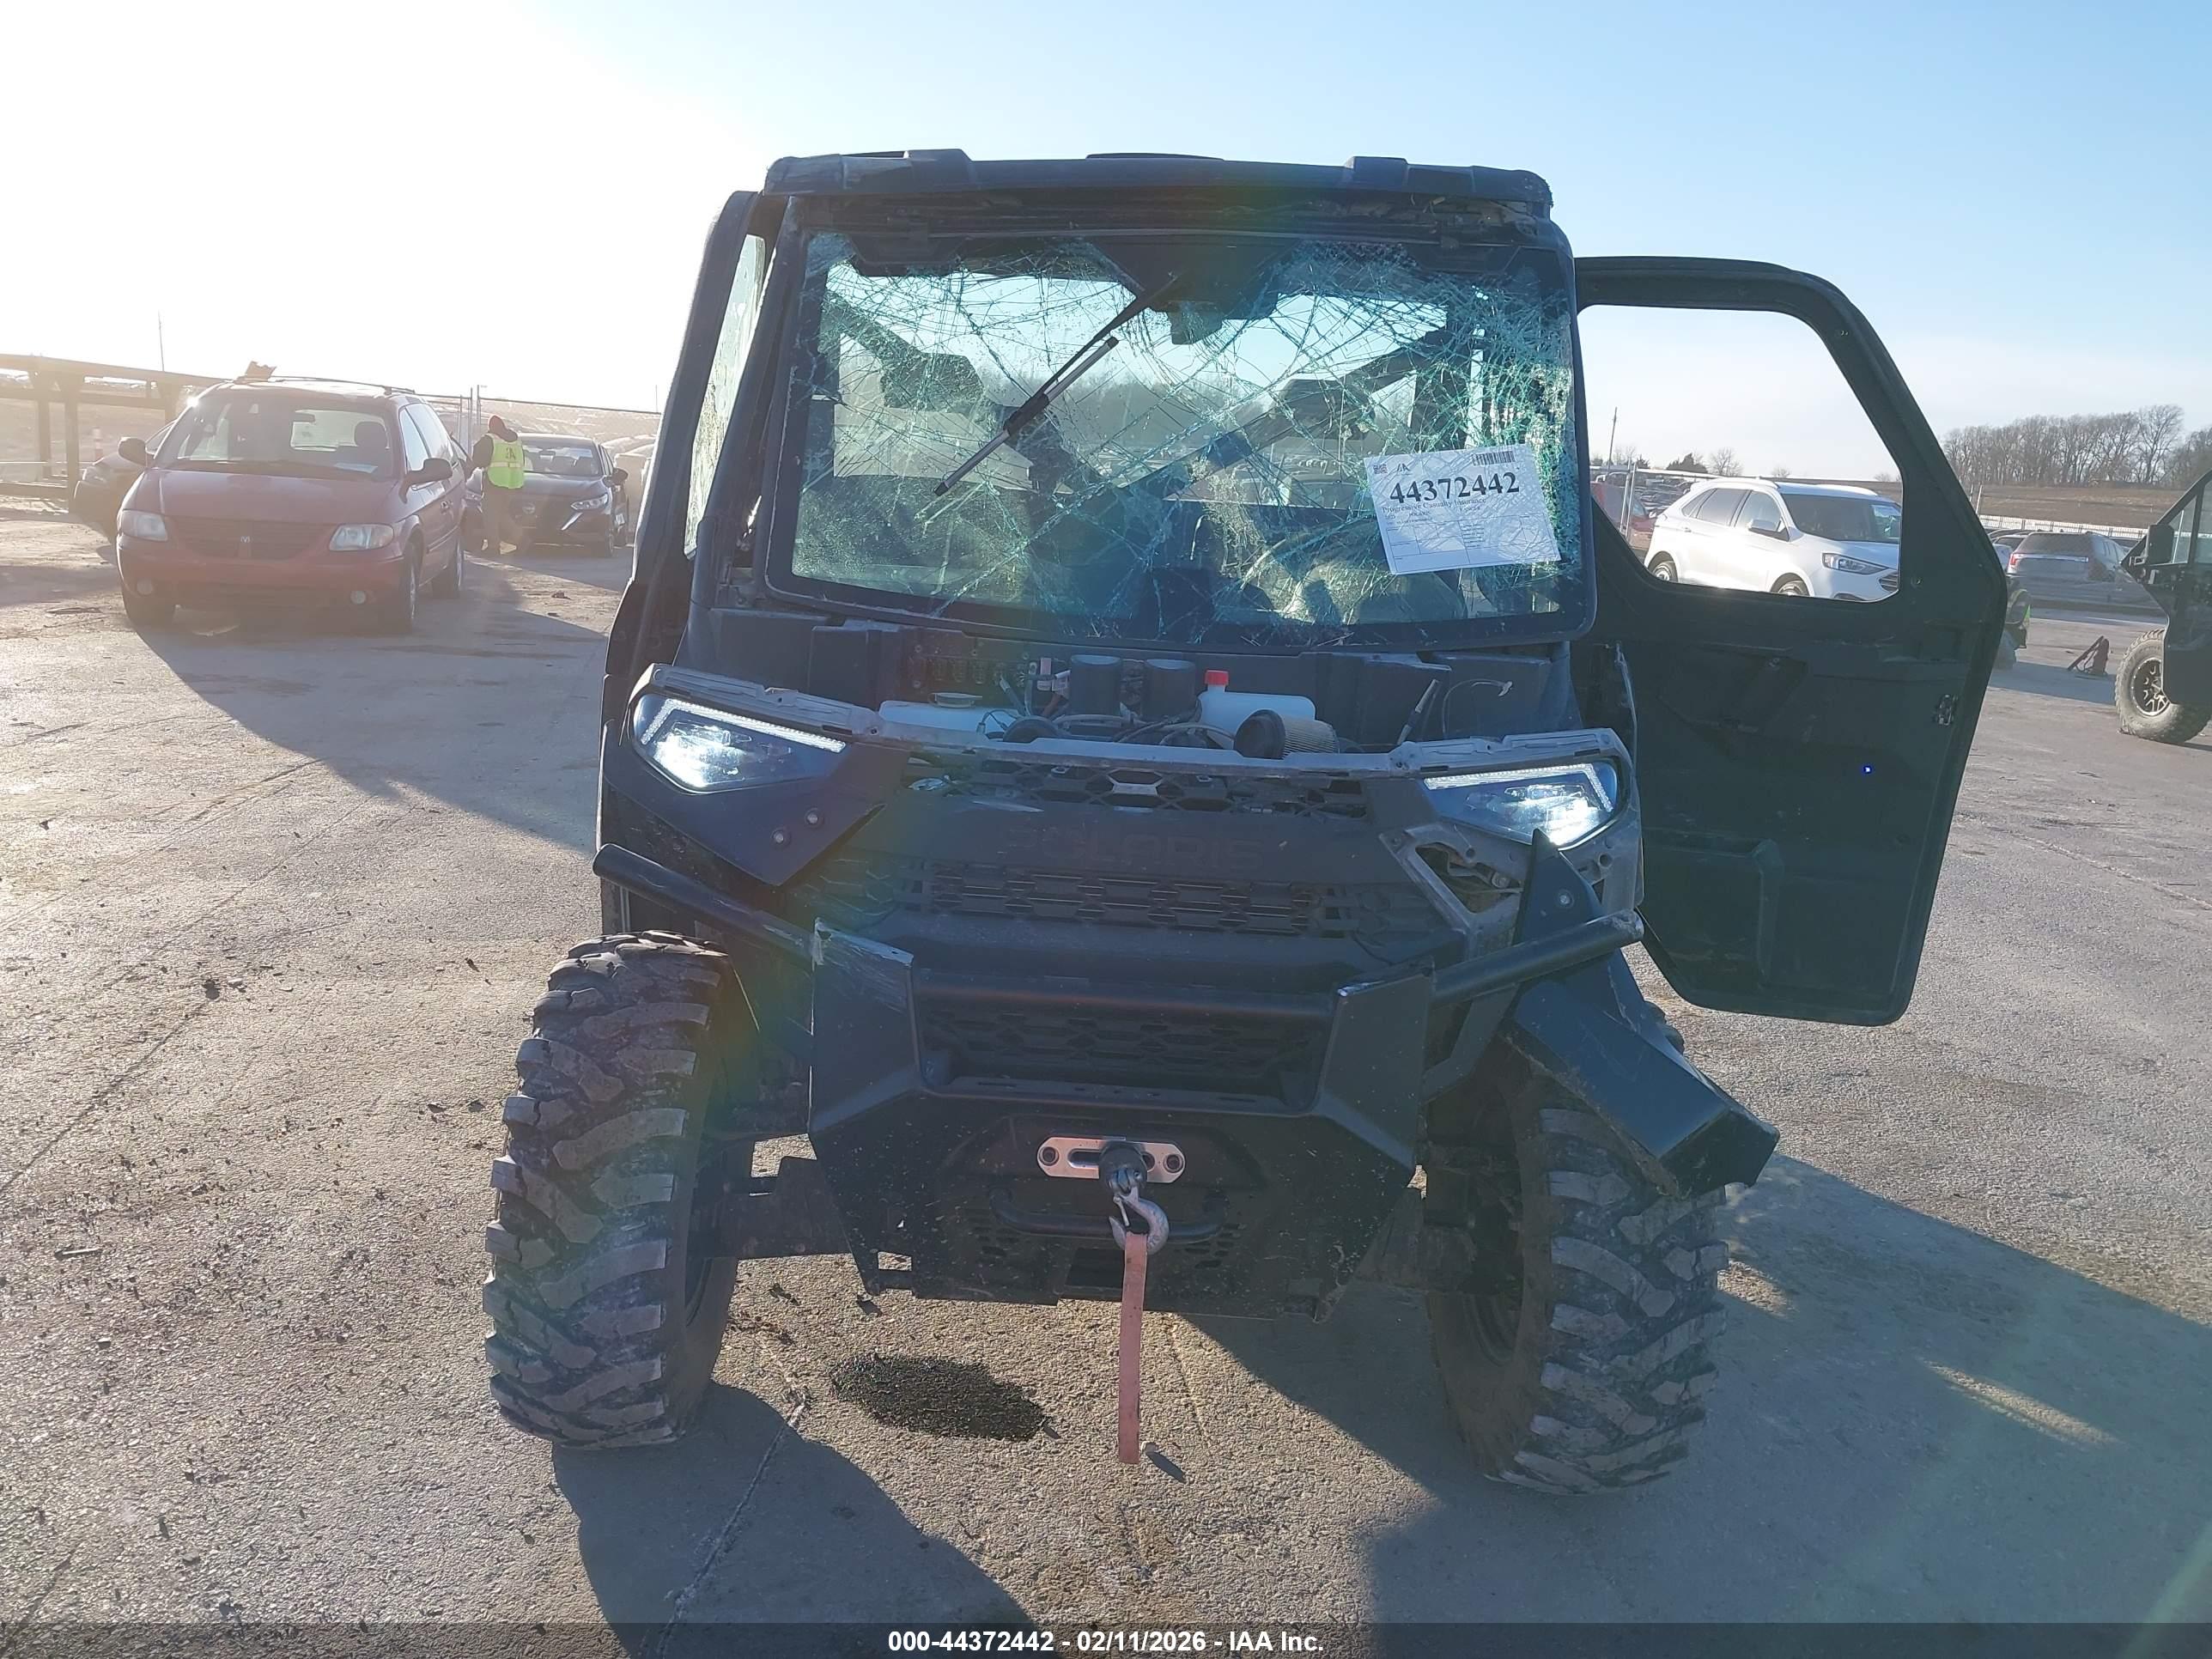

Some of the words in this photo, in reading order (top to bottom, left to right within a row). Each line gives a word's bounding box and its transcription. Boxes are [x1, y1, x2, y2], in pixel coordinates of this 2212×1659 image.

[1389, 471, 1520, 504] 44372442
[1382, 503, 1422, 514] Progressive
[1422, 500, 1453, 509] Casualty
[1454, 498, 1486, 507] Insurance
[1002, 825, 1265, 871] POLARIS
